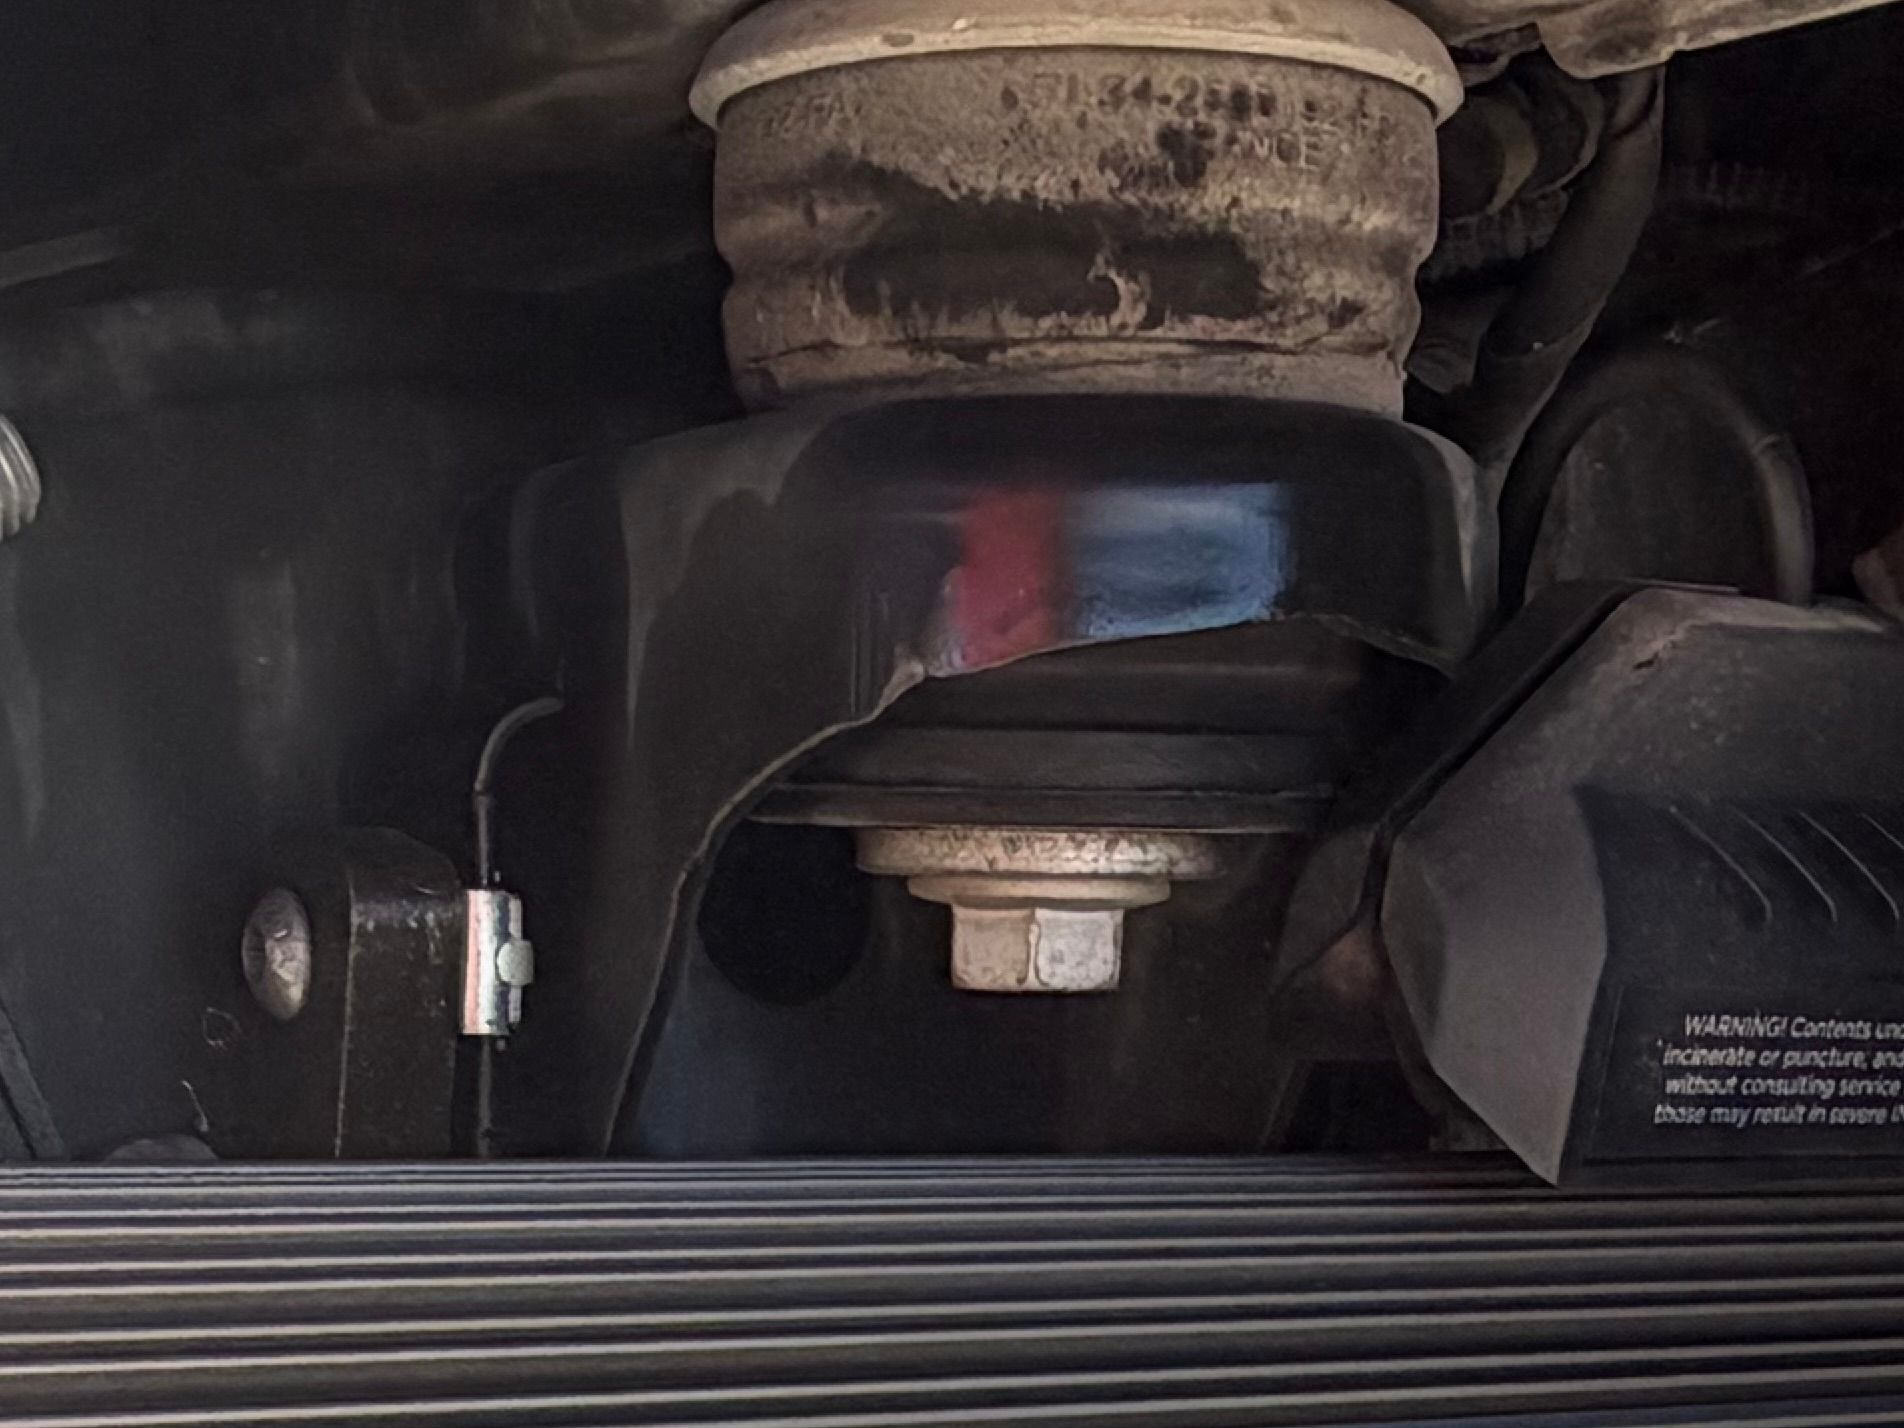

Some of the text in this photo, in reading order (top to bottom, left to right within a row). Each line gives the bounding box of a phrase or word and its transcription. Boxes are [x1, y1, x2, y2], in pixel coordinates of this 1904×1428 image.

[1685, 1013, 1788, 1037] WARNING!
[1790, 1015, 1871, 1040] Contents
[1663, 1045, 1756, 1066] incinerate
[1758, 1050, 1780, 1066] or
[1665, 1073, 1738, 1095] without
[1741, 1073, 1836, 1100] consulting
[1839, 1074, 1902, 1097] service
[1709, 1106, 1752, 1129] may
[1752, 1104, 1806, 1125] result
[1807, 1104, 1827, 1124] in
[1829, 1107, 1888, 1124] severe
